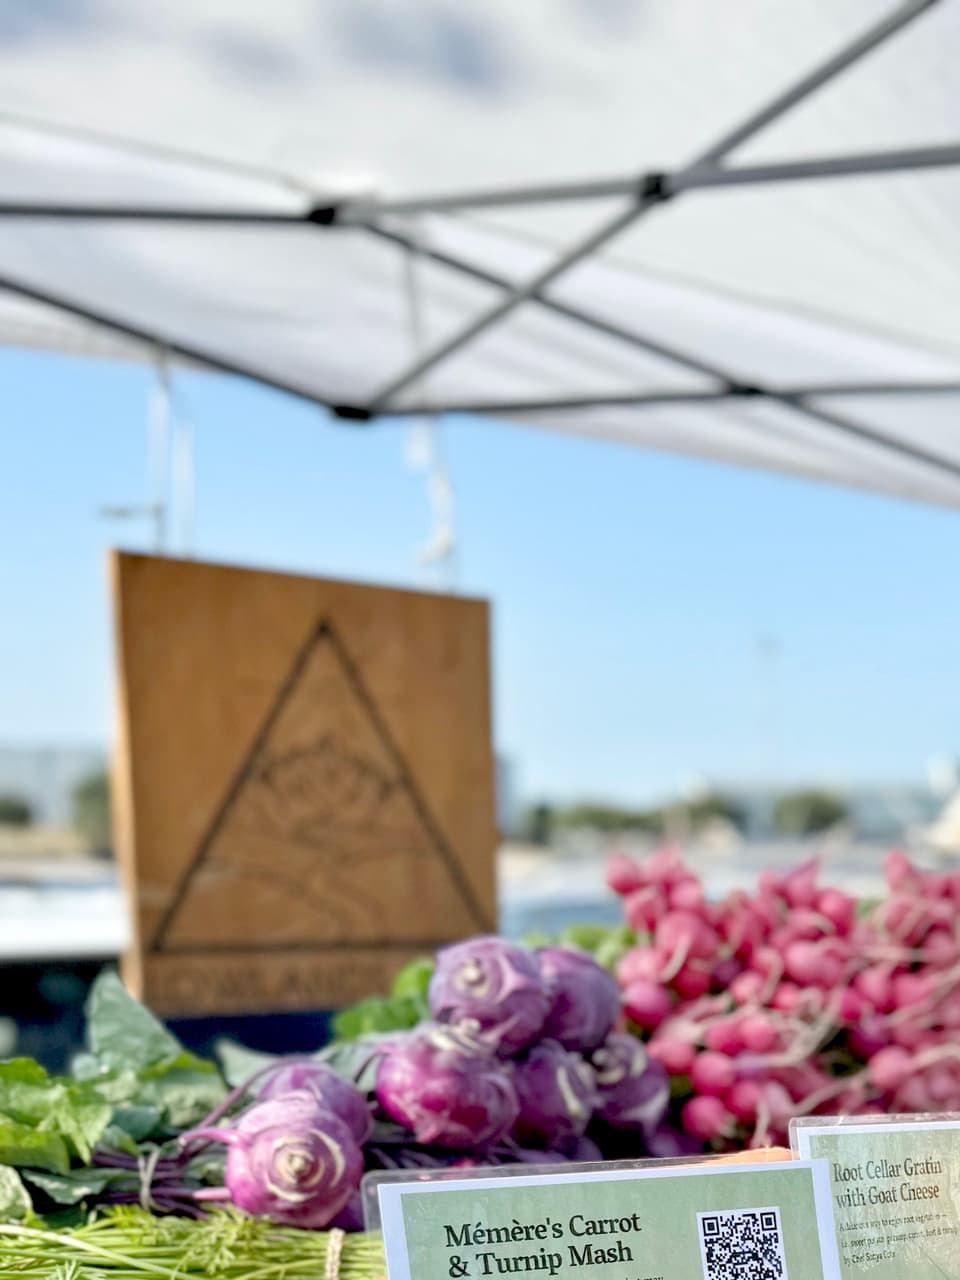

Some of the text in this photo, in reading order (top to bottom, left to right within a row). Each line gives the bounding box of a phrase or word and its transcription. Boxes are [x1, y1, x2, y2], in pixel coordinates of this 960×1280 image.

[833, 1156, 943, 1182] Root Cellar Gratin
[836, 1181, 940, 1209] with Goat Cheese
[442, 1212, 642, 1248] Mémère's Carrot
[448, 1240, 634, 1278] & Turnip Mash
